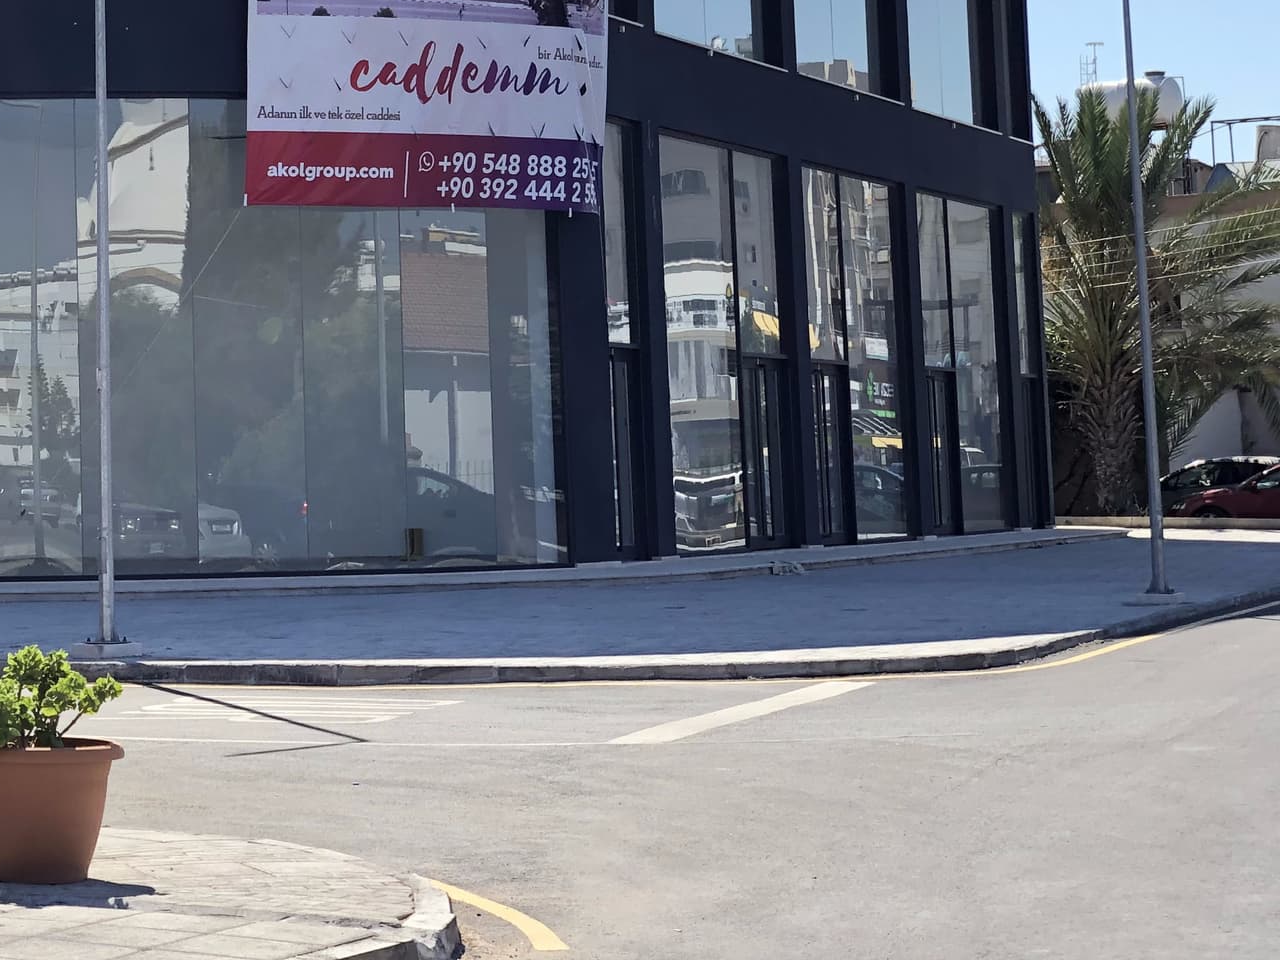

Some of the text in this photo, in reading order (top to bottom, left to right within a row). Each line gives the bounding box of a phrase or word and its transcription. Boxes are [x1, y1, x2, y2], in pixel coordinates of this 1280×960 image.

[537, 45, 551, 60] bir
[349, 40, 570, 105] caddemm
[257, 105, 401, 121] Adanın ilk ve tek özel caddesi
[266, 162, 394, 182] akolgroup.com
[438, 151, 477, 174] +90
[482, 152, 521, 176] 548
[527, 154, 567, 178] 888
[436, 176, 474, 199] +90
[479, 177, 519, 200] 392
[524, 179, 567, 203] 444
